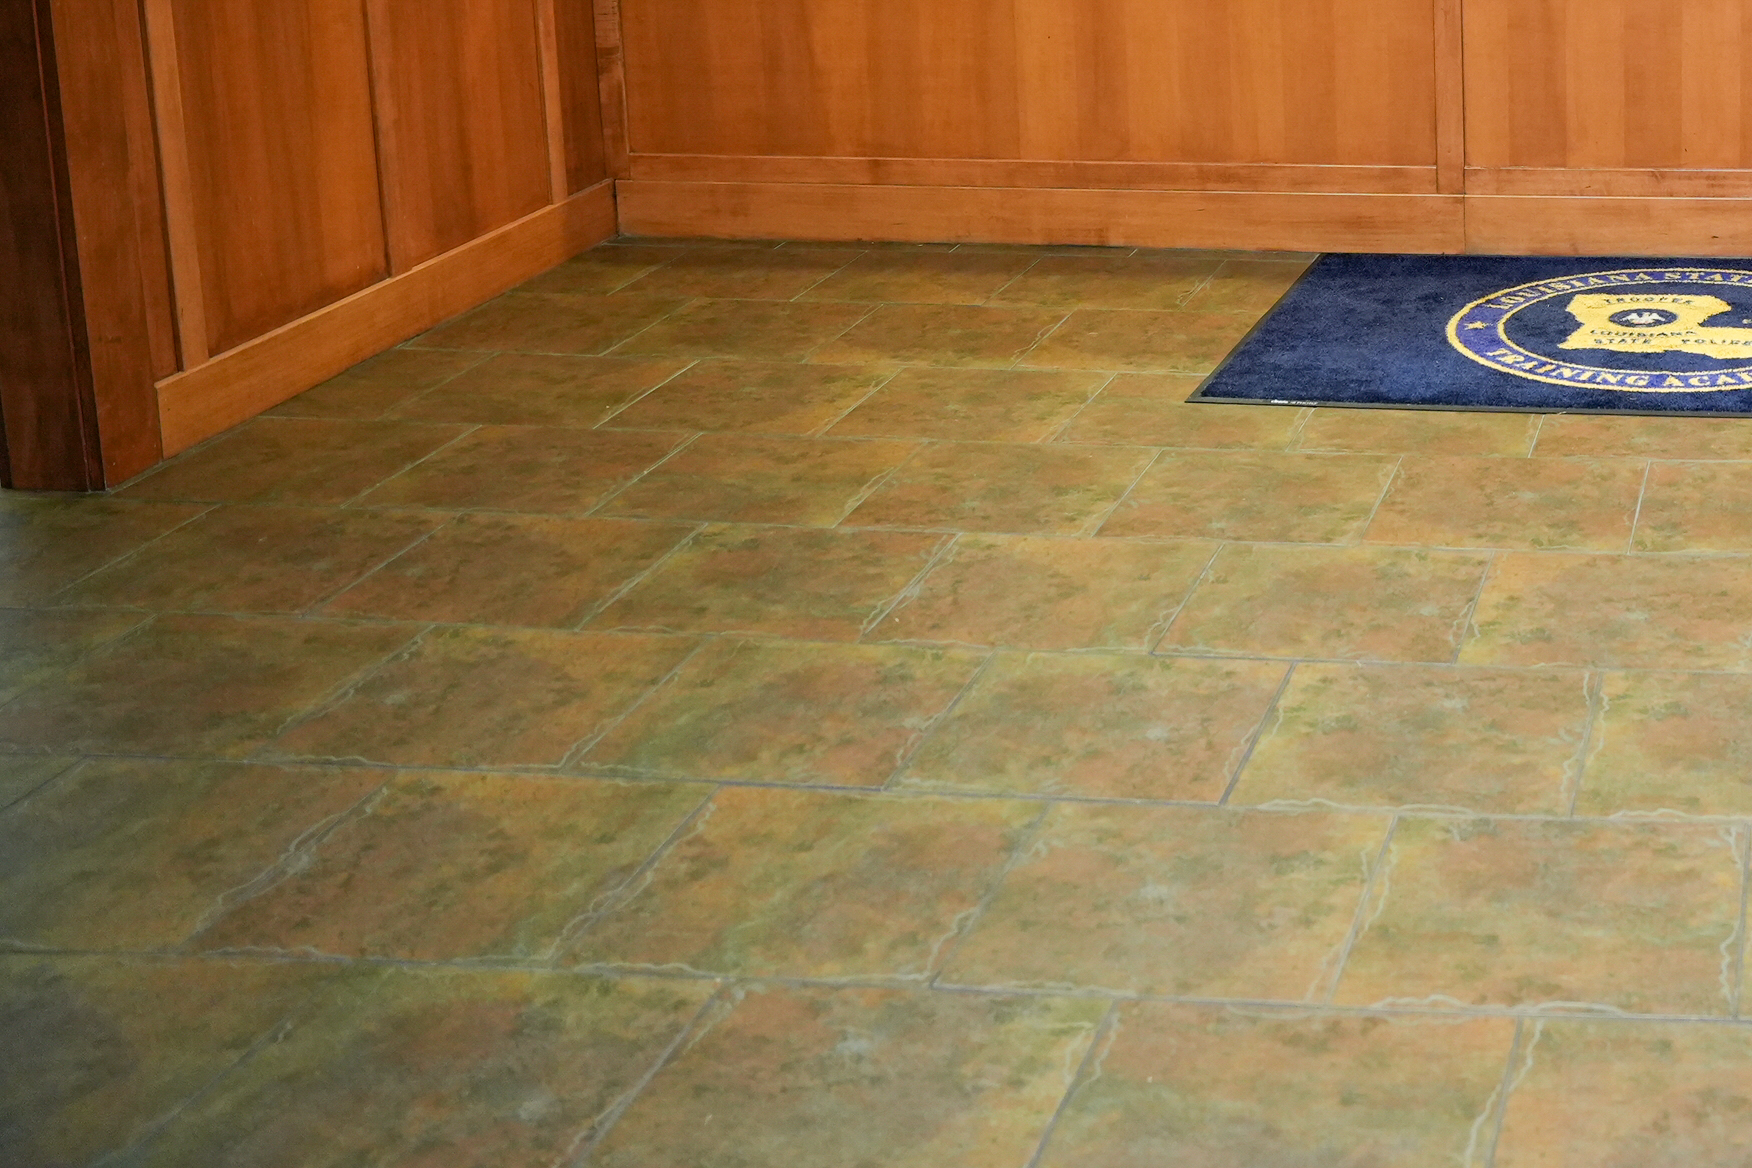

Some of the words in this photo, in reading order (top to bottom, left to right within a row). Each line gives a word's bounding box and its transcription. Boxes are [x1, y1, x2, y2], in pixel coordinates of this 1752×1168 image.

[1485, 271, 1654, 310] LOUISIANA
[1590, 329, 1698, 338] LOUISIANA
[1486, 347, 1650, 387] TRAINING
